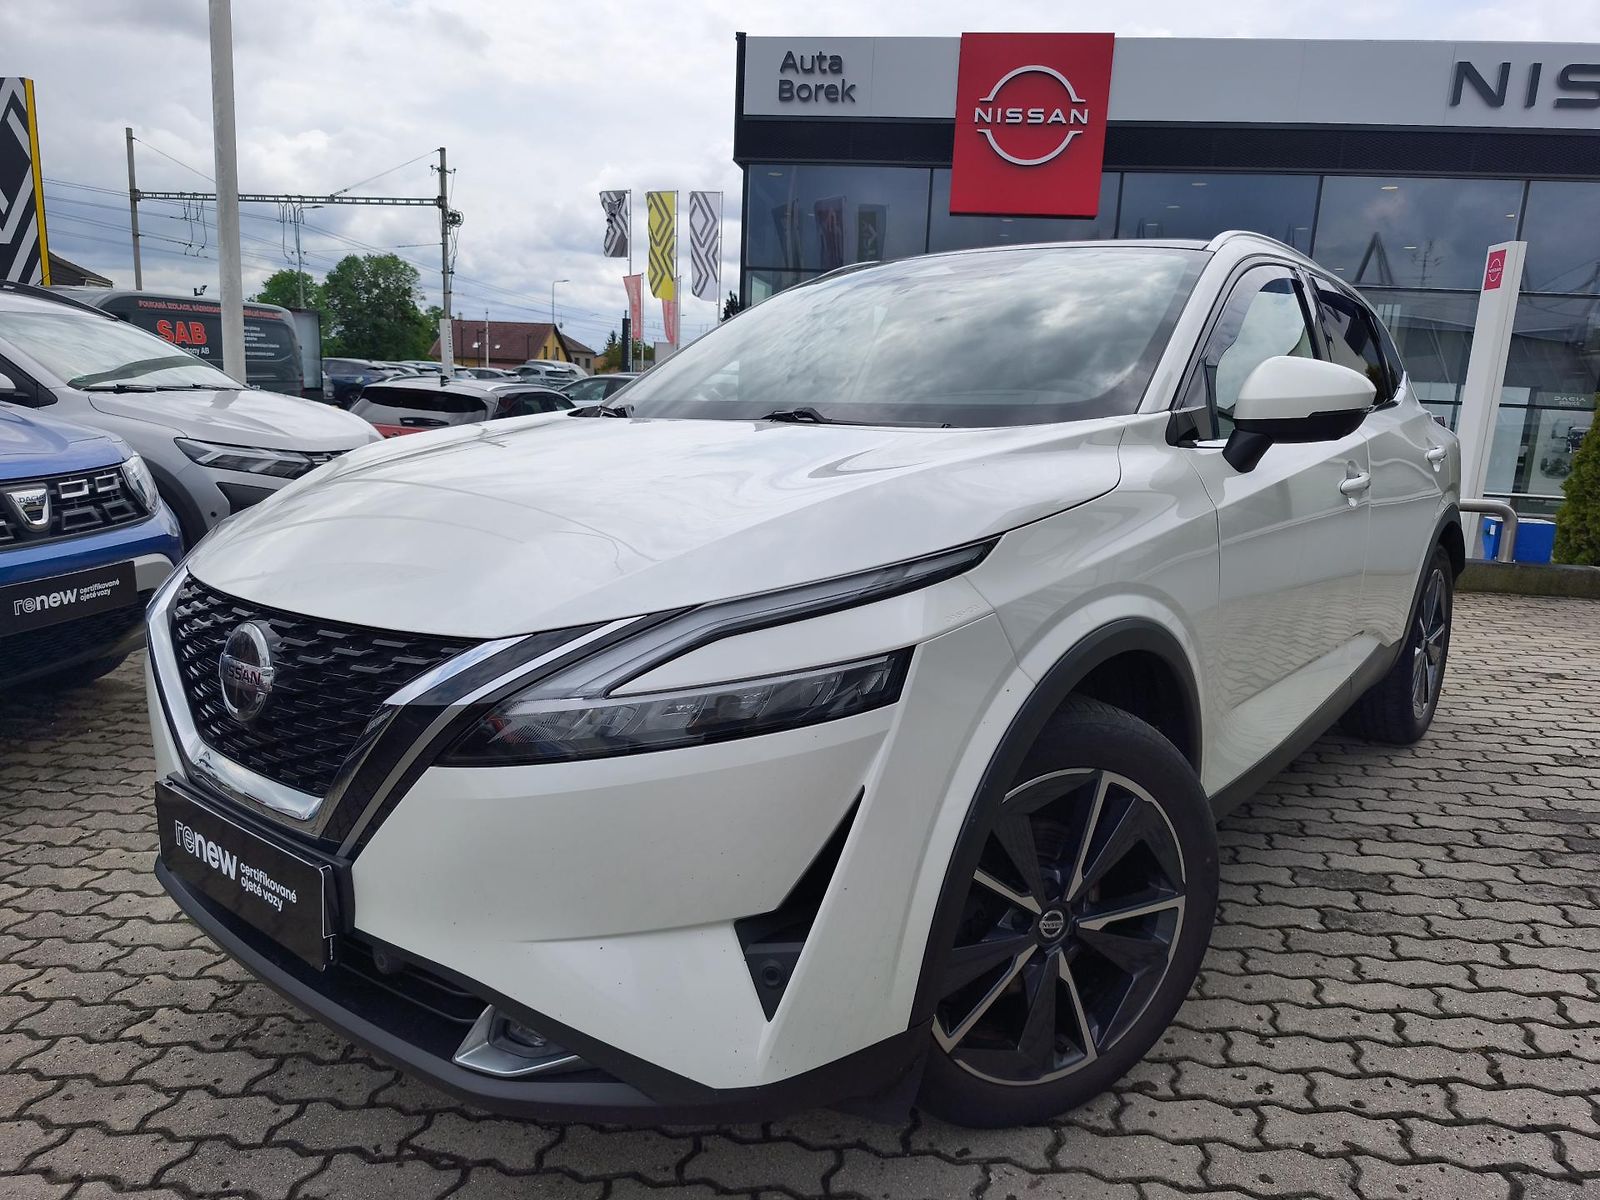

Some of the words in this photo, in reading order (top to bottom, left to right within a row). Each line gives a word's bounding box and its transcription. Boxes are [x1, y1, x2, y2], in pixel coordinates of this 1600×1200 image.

[780, 50, 842, 74] Auta
[778, 79, 856, 103] Borek
[1450, 61, 1600, 108] NIS
[974, 107, 1089, 124] NISSAN
[156, 319, 207, 345] SAB
[79, 578, 120, 594] certifikované
[79, 590, 97, 602] ojeté
[97, 588, 111, 598] vozy
[13, 588, 78, 616] renew
[174, 820, 238, 881] renew
[240, 862, 297, 904] certifikované
[241, 876, 263, 897] ojeté
[263, 889, 283, 912] vozy
